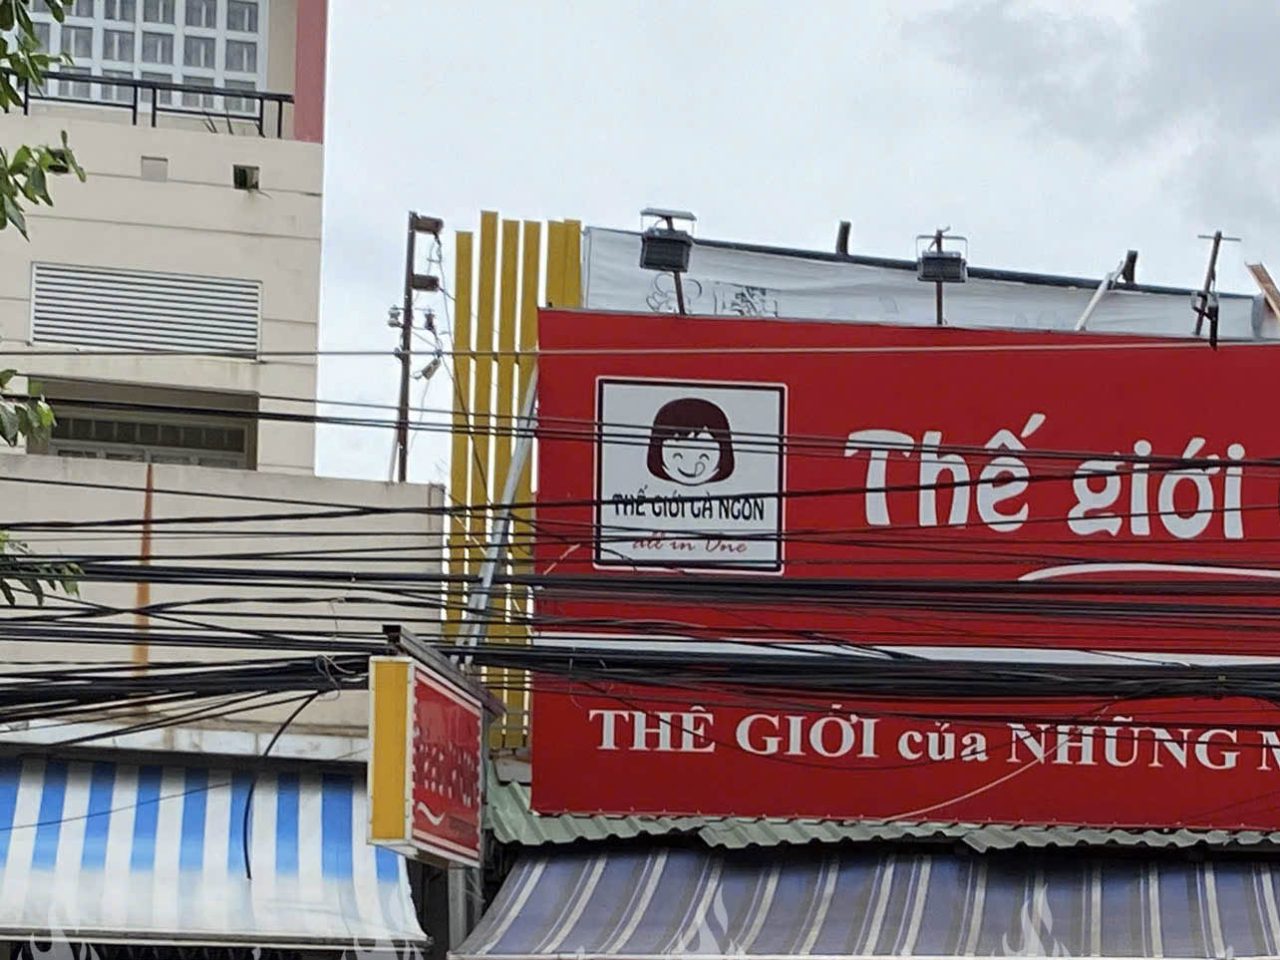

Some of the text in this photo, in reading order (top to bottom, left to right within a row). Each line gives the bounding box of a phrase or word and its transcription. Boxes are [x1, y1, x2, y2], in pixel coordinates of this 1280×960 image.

[718, 497, 765, 521] NGON
[844, 413, 1045, 532] Thế
[1067, 437, 1246, 540] giới
